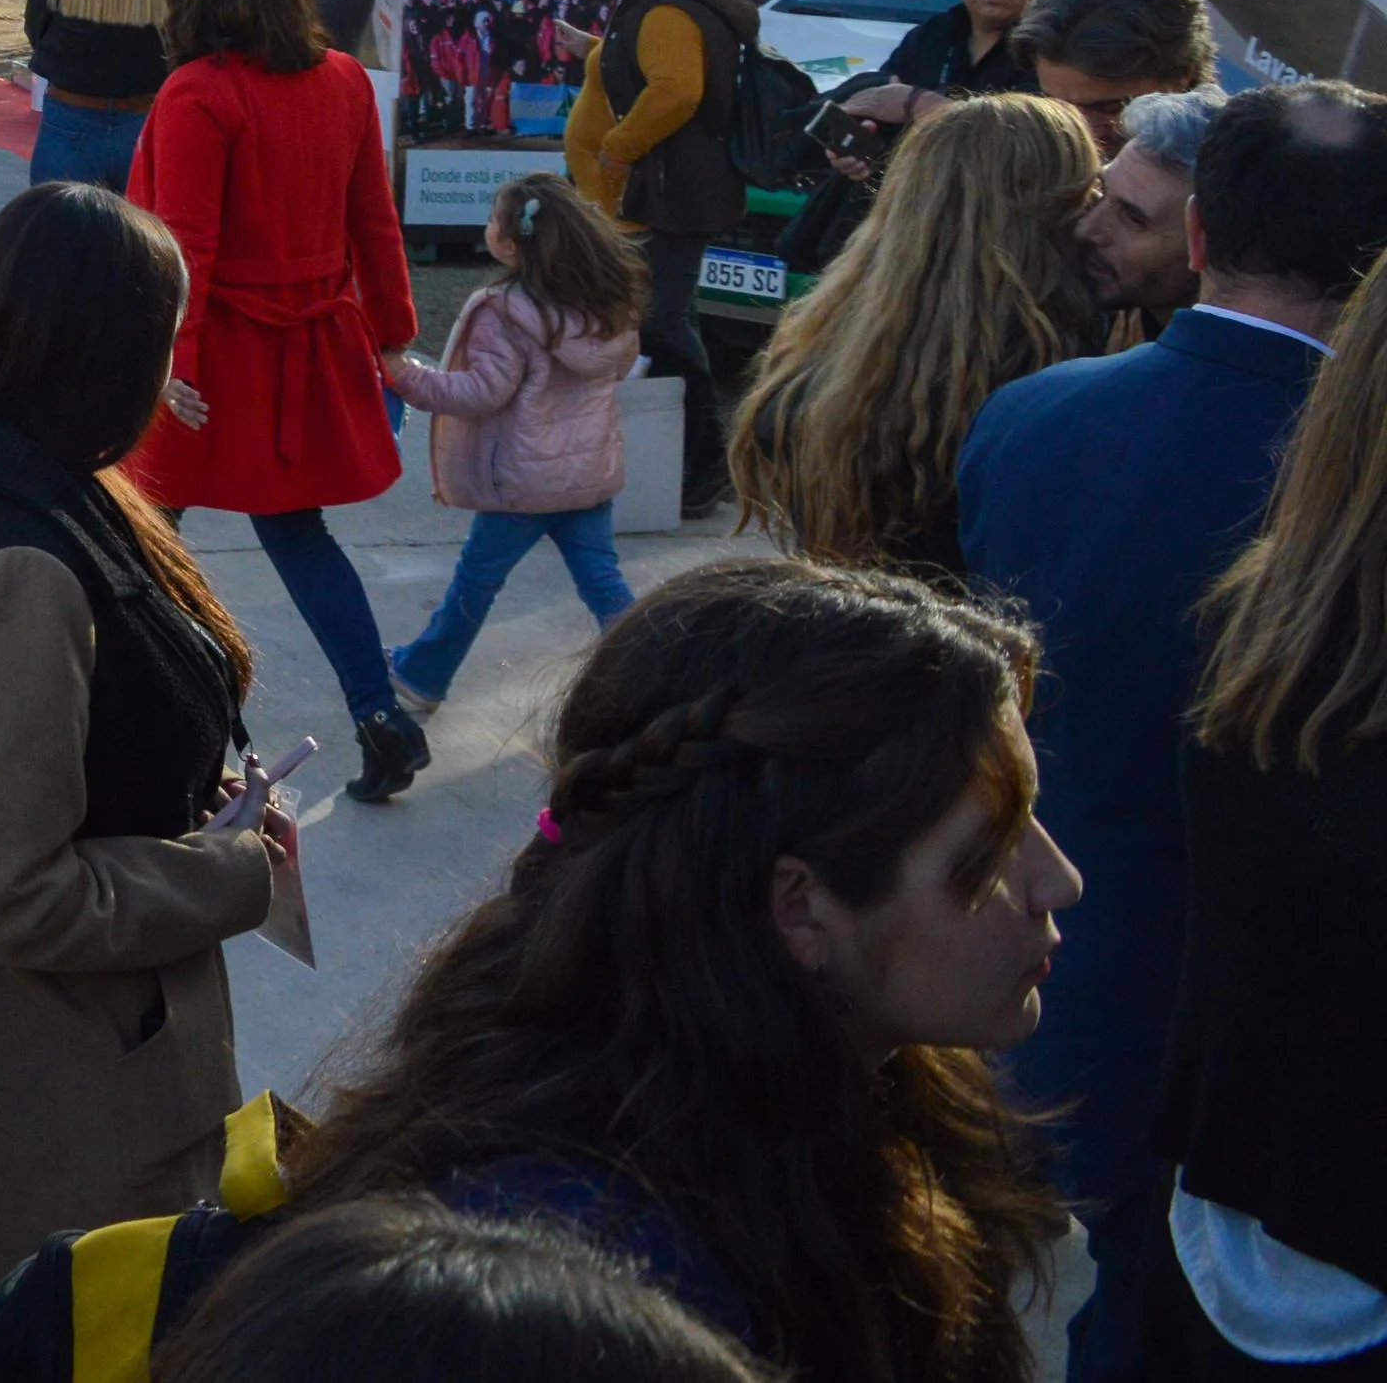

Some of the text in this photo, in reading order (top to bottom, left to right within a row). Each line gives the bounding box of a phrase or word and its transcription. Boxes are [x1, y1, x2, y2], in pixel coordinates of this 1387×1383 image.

[420, 168, 462, 183] Donde
[464, 167, 490, 184] está
[494, 169, 506, 183] el
[420, 189, 475, 204] Nosotros
[707, 261, 778, 293] 855 SC
